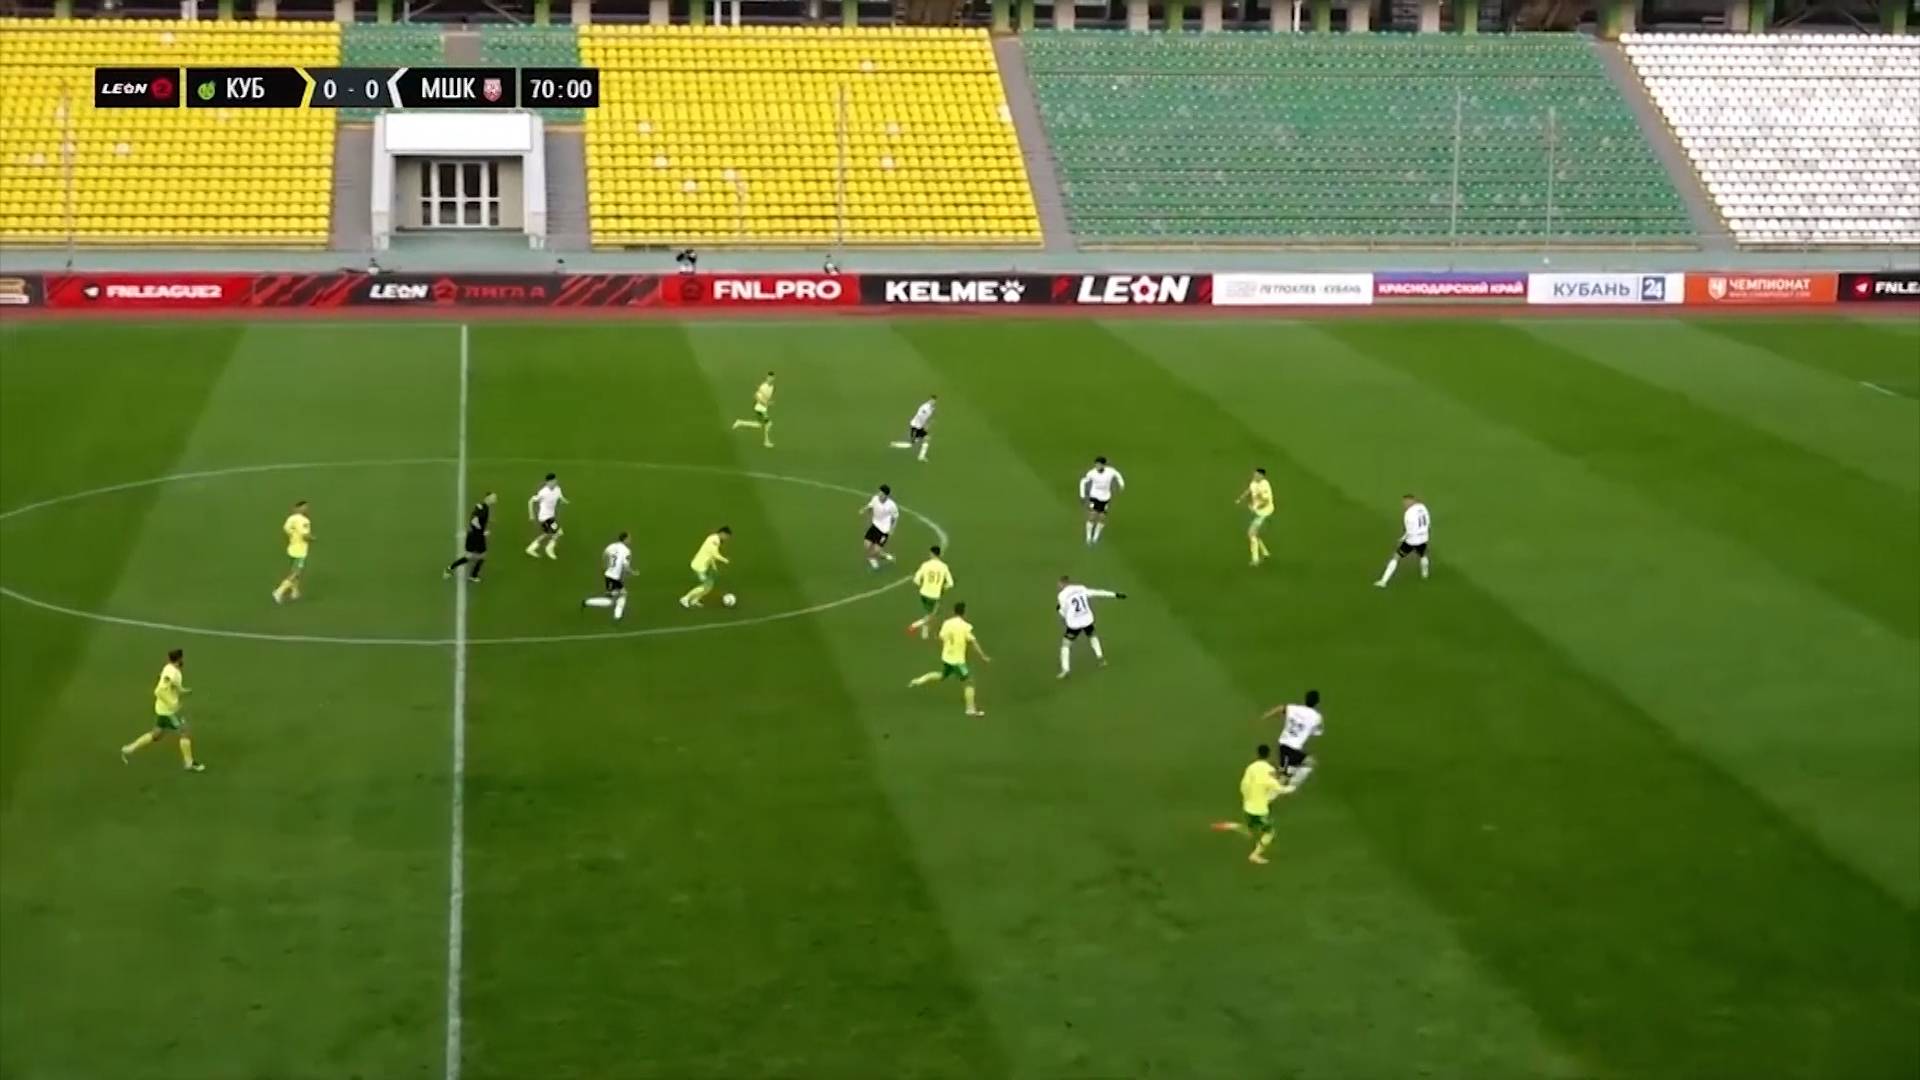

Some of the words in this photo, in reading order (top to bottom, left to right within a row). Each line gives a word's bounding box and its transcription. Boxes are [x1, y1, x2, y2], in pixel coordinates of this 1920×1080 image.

[369, 283, 430, 299] LEON
[885, 280, 998, 302] KELME
[1076, 275, 1192, 304] LEON
[1378, 280, 1489, 295] КРАСНОДАРСКИЙ
[1490, 280, 1524, 295] КРАЙ
[1553, 282, 1631, 297] КУБАНЬ
[1643, 278, 1664, 299] 24
[1729, 278, 1811, 290] ЧЕМПИОНАТ
[1875, 281, 1920, 295] FNLE
